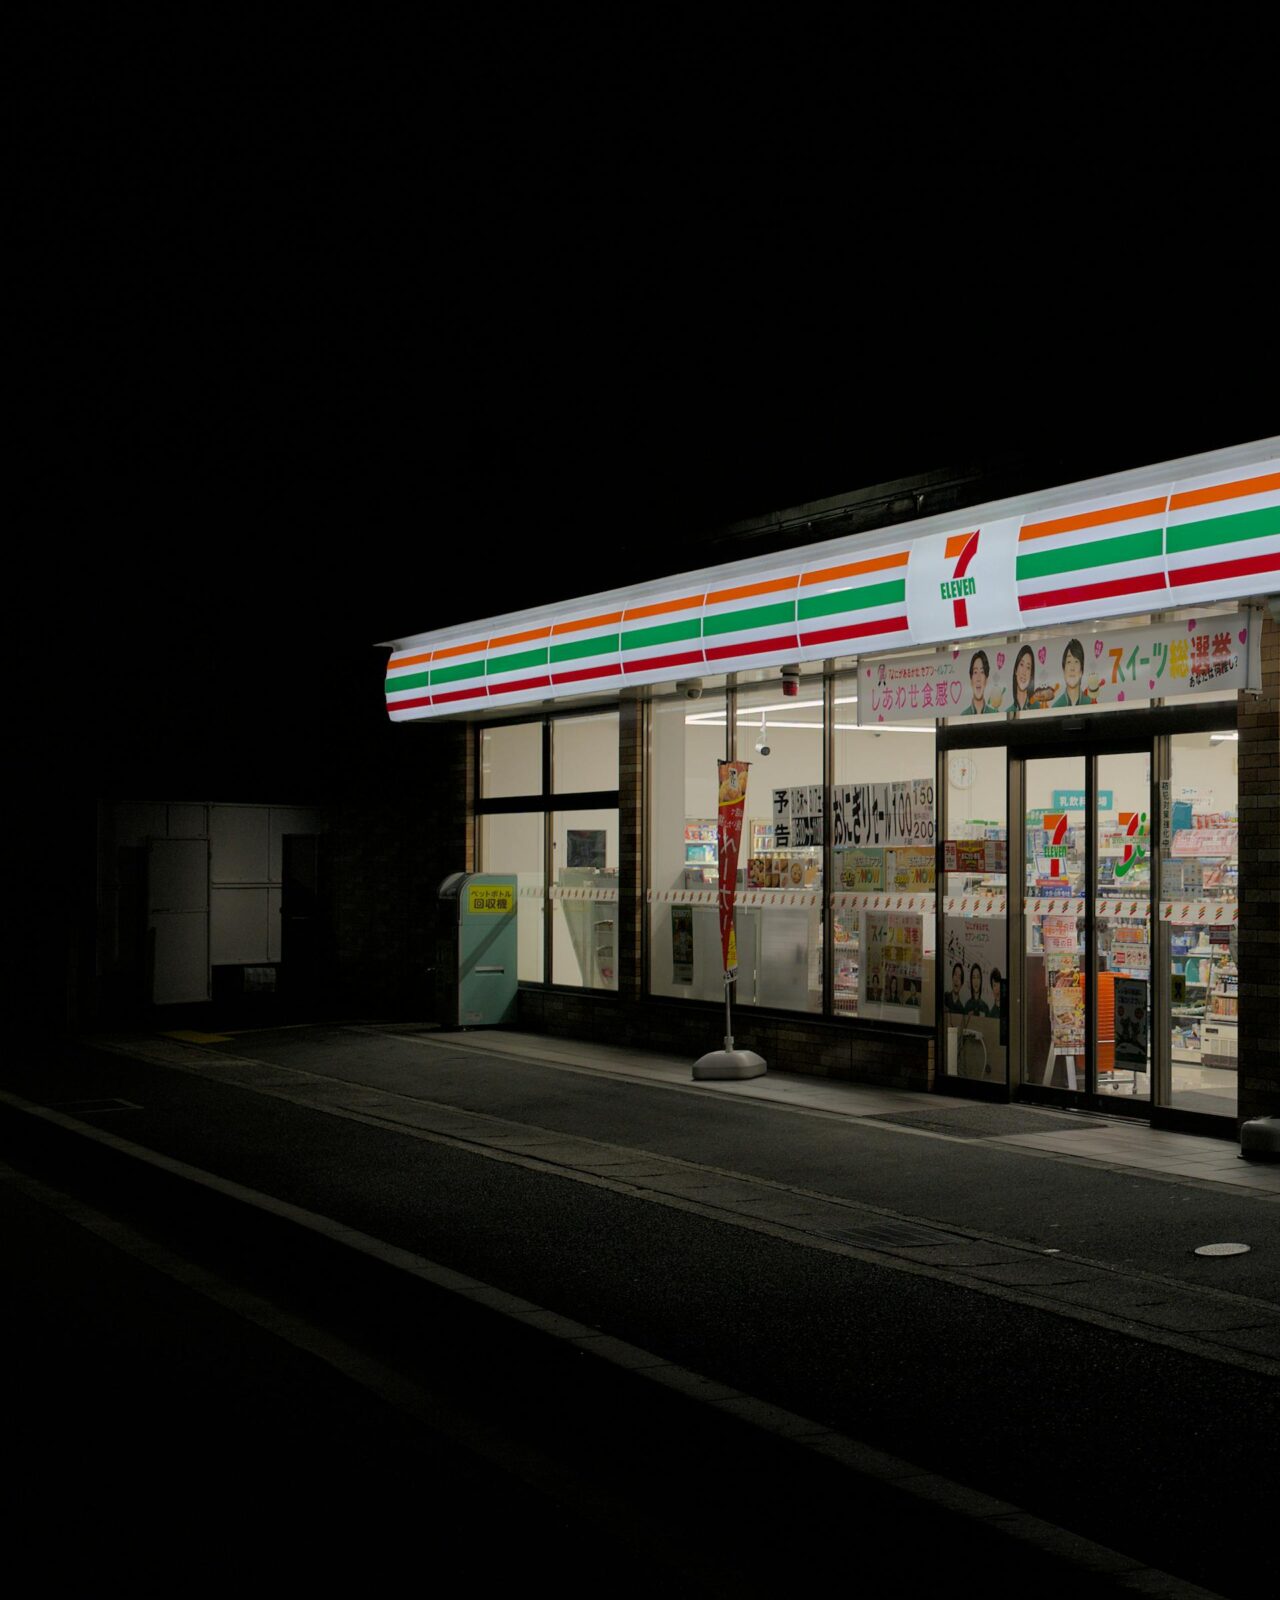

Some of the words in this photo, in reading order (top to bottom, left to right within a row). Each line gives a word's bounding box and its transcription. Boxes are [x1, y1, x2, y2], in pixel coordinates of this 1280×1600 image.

[944, 529, 980, 628] 7
[913, 786, 933, 806] 150
[774, 790, 790, 848] 予告
[913, 821, 934, 839] 200
